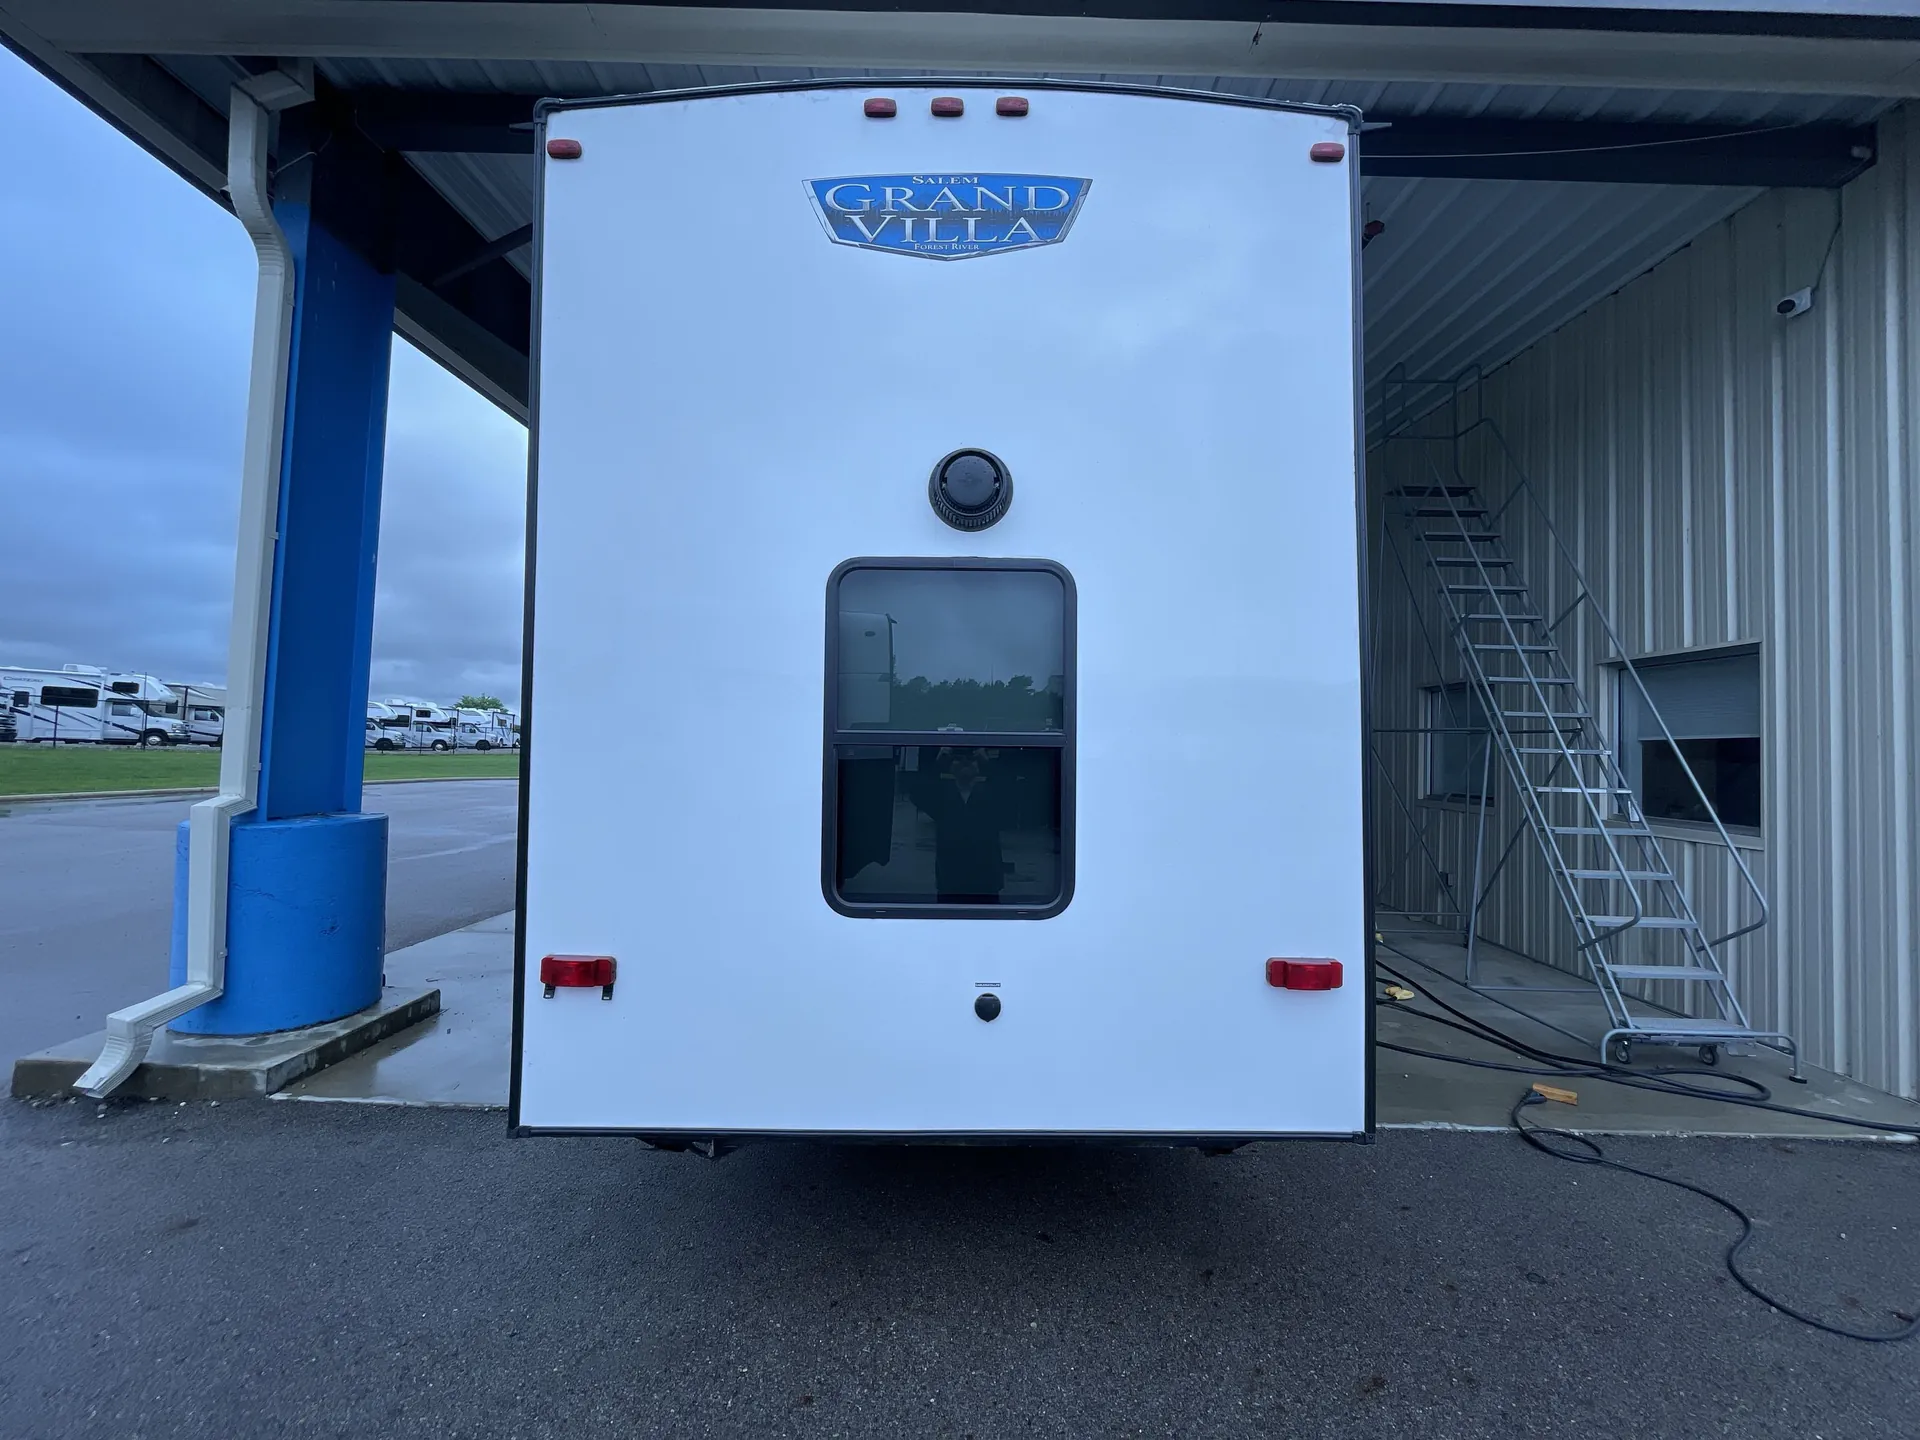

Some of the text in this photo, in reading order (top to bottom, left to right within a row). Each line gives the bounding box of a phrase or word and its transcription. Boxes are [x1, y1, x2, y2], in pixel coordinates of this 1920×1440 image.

[912, 175, 978, 184] SALEM
[825, 184, 1070, 212] GRAND
[844, 215, 1044, 243] VILLA
